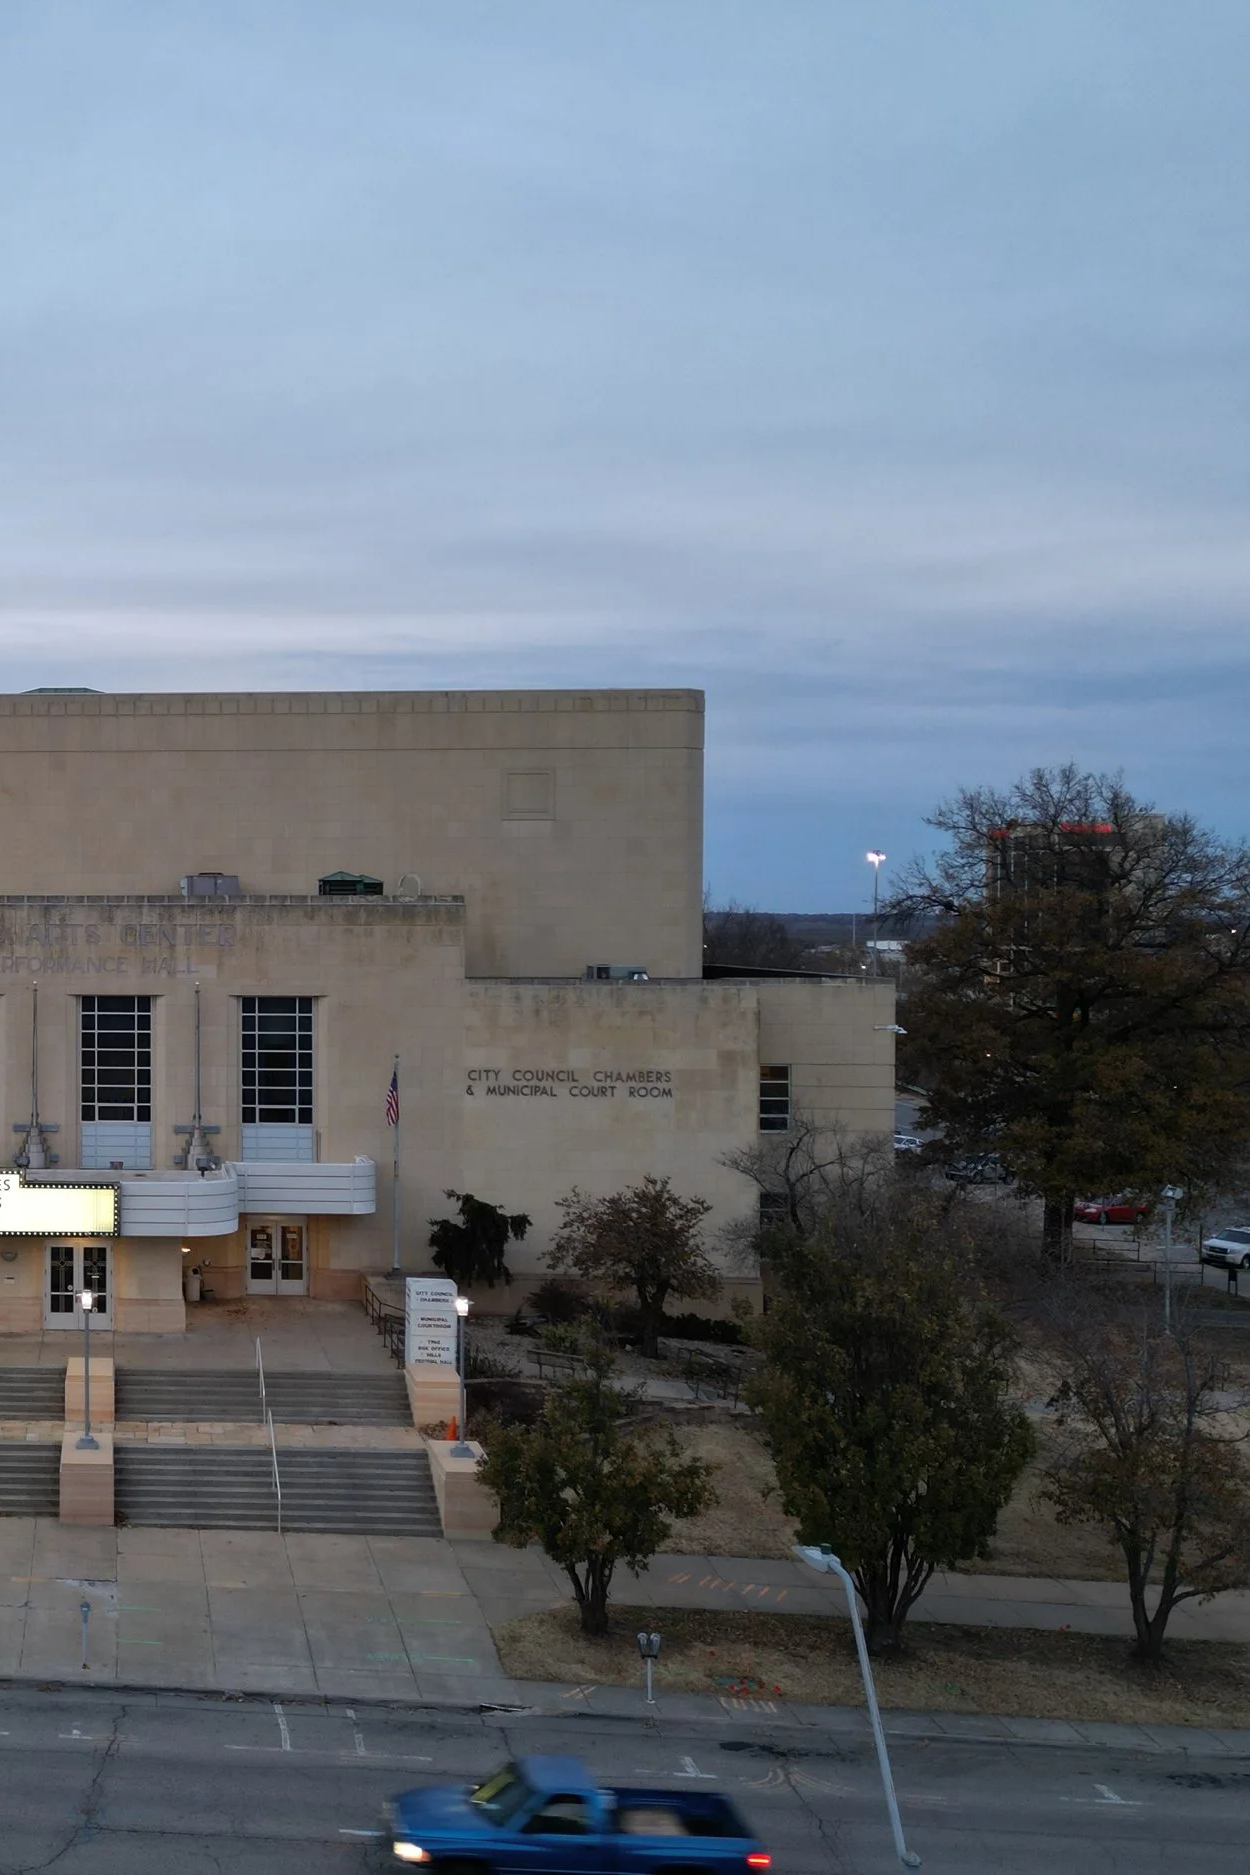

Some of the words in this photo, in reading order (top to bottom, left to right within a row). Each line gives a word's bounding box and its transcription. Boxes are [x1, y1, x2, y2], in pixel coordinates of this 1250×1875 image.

[25, 923, 102, 947] ARTS
[119, 923, 239, 948] CENTER
[141, 957, 201, 976] HALL
[467, 1069, 500, 1082] CITY
[512, 1070, 579, 1082] COUNCIL
[593, 1070, 672, 1083] CHAMBERS
[465, 1085, 475, 1096] &
[486, 1085, 557, 1097] MUNICIPAL
[569, 1086, 617, 1098] COURT
[629, 1086, 673, 1098] ROOM
